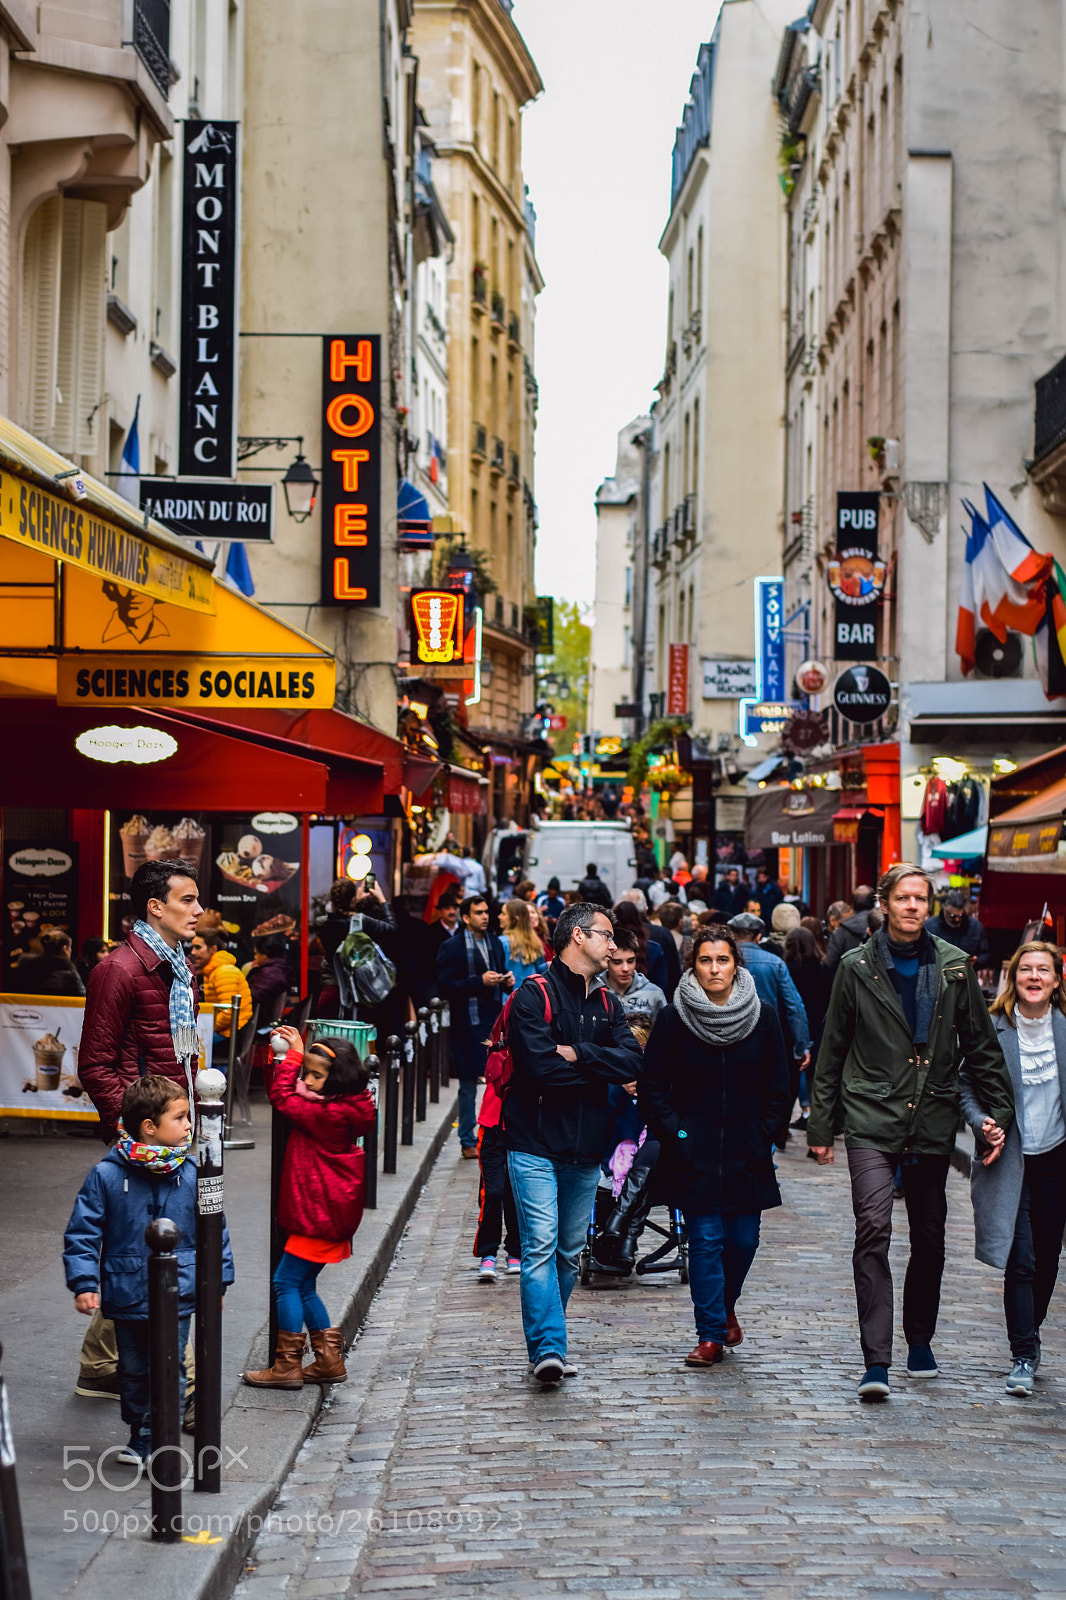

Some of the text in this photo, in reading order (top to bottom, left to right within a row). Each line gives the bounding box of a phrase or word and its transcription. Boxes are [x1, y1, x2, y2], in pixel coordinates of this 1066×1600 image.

[194, 163, 225, 463] MONT BLANC
[326, 339, 375, 600] HOTEL
[209, 501, 232, 522] DU
[236, 502, 268, 522] ROI
[839, 509, 876, 529] PUB
[20, 486, 83, 559] SCIENCES
[88, 520, 149, 586] HUMAINES
[766, 584, 780, 700] SOUVLAKI
[837, 623, 874, 643] BAR
[76, 669, 315, 699] SCIENCES SOCIALES
[837, 691, 886, 704] GUINNESS
[771, 831, 825, 844] Bar Latino
